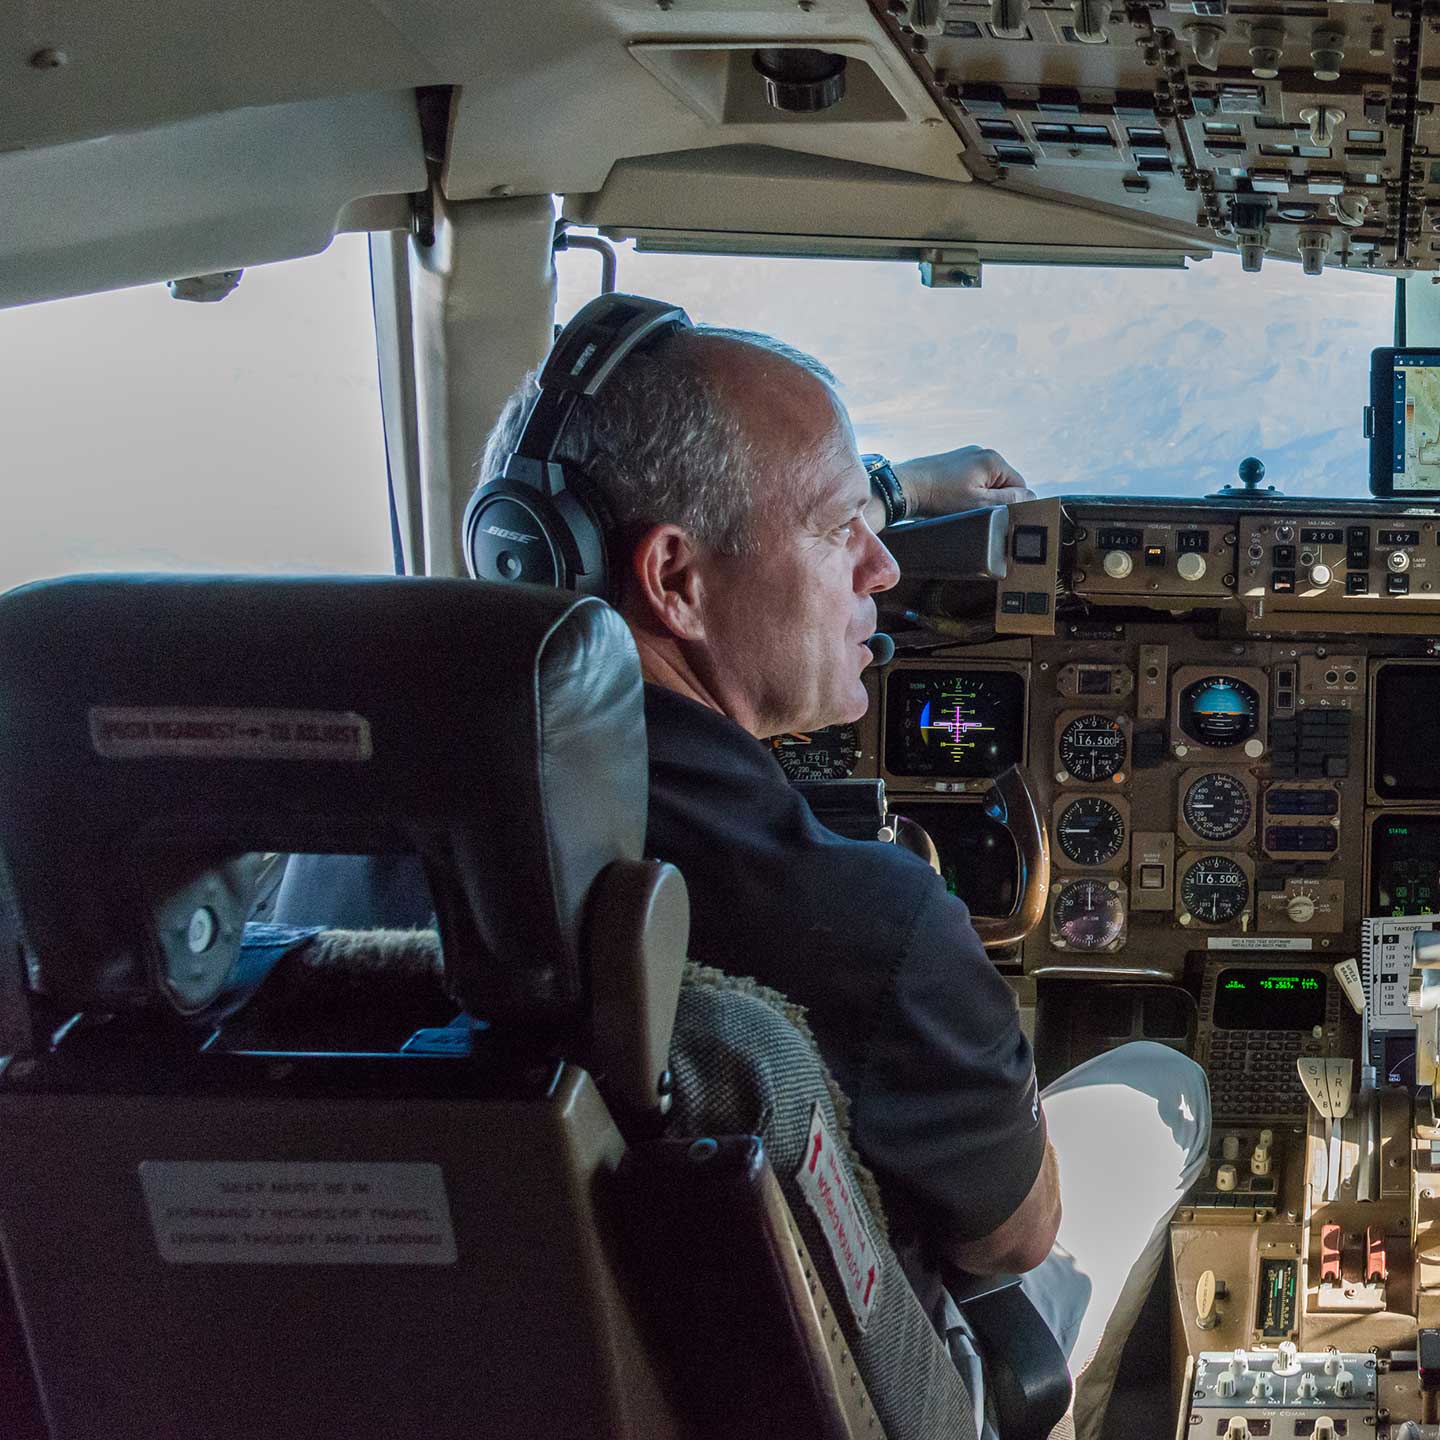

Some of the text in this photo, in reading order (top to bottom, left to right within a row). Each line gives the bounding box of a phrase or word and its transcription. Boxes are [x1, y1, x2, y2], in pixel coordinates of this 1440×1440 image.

[482, 525, 540, 544] BOSE
[1312, 532, 1334, 540] 290
[1388, 534, 1410, 542] 167
[1078, 736, 1115, 746] 16.500
[1200, 874, 1238, 884] 16.500
[1340, 967, 1353, 984] BRAKE
[1346, 964, 1358, 982] SPEED
[1308, 1066, 1328, 1108] STAB
[1335, 1066, 1344, 1108] TRIM
[219, 1182, 370, 1195] SEAT MUST BE IN
[166, 1208, 252, 1221] FORWARD
[368, 1208, 433, 1221] TRAVEL
[170, 1233, 239, 1247] DURING
[323, 1233, 360, 1247] AND
[365, 1233, 442, 1247] LANDING
